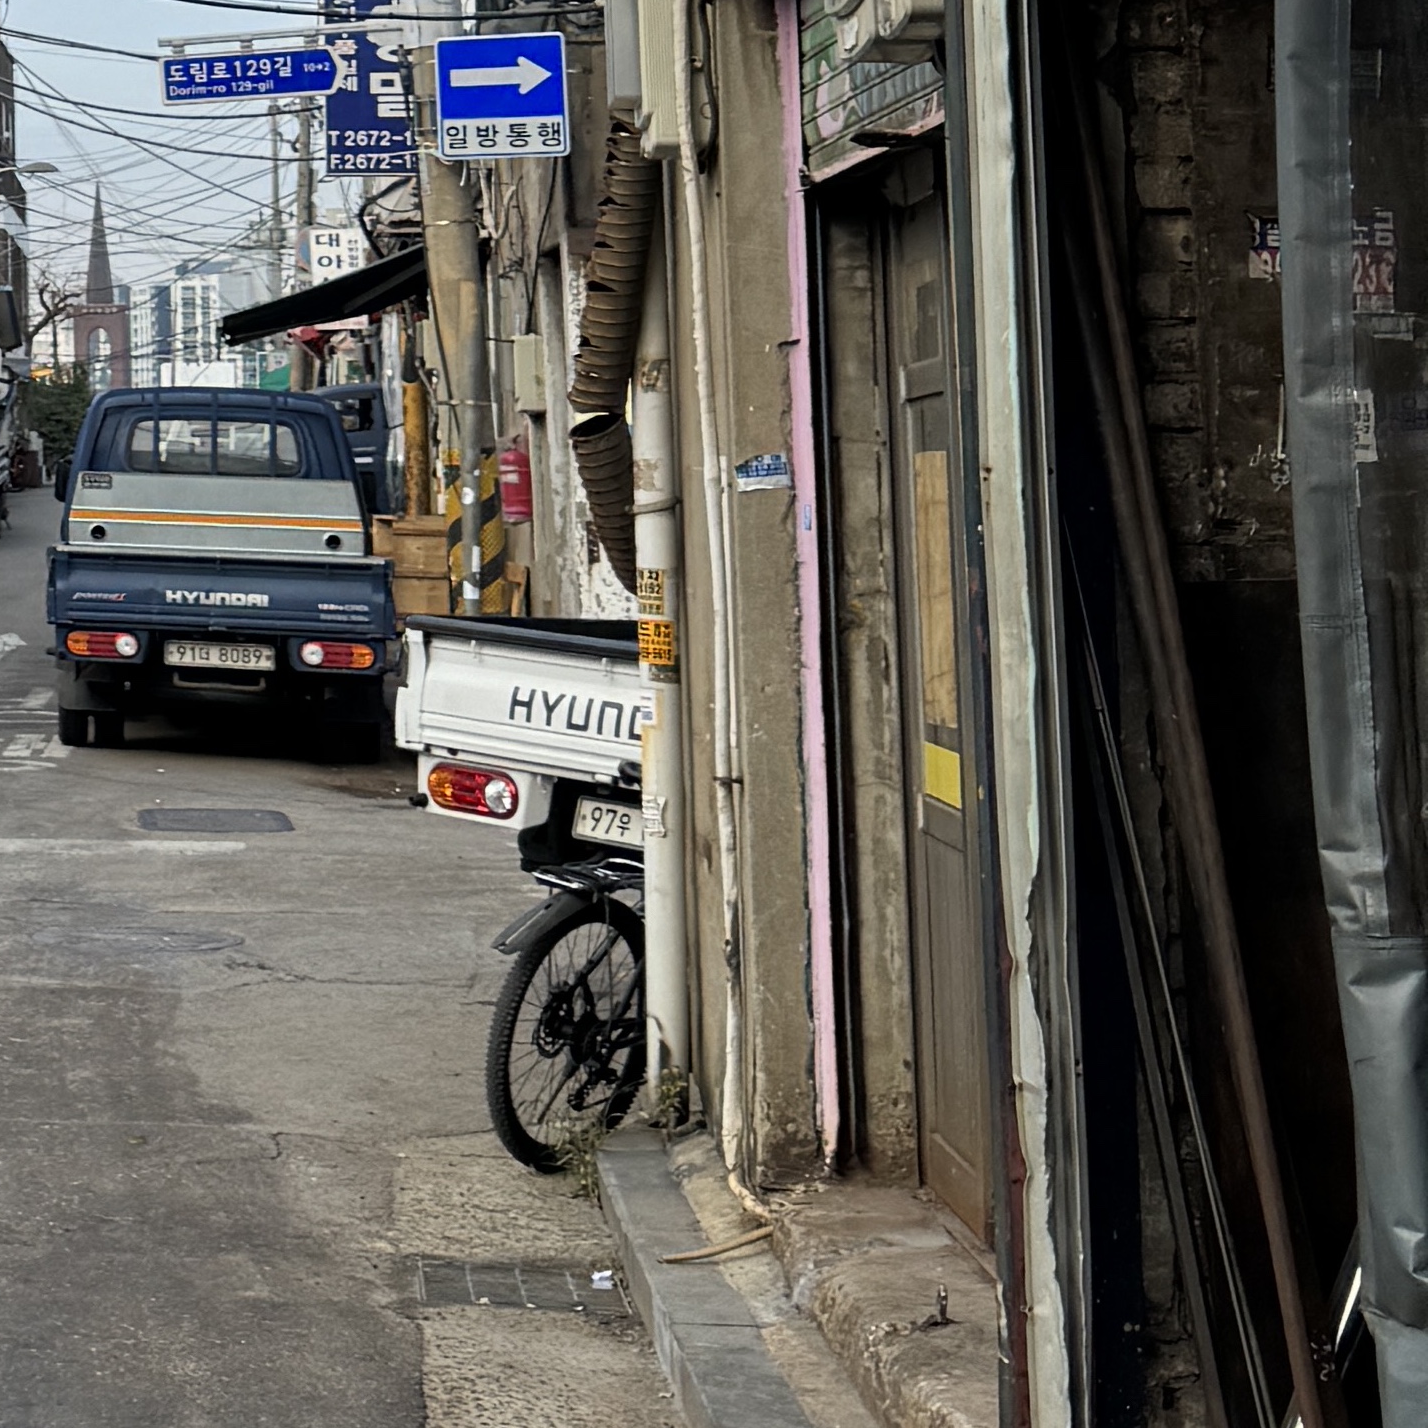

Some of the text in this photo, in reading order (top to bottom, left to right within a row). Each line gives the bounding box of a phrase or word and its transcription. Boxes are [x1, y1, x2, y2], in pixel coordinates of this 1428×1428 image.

[167, 55, 293, 83] 도림로129길
[169, 79, 274, 97] Dorim-ro 129-gil
[445, 120, 562, 150] 일방통행
[314, 233, 344, 282] 대아
[165, 589, 269, 608] HYUNDAI
[590, 806, 632, 837] 97우
